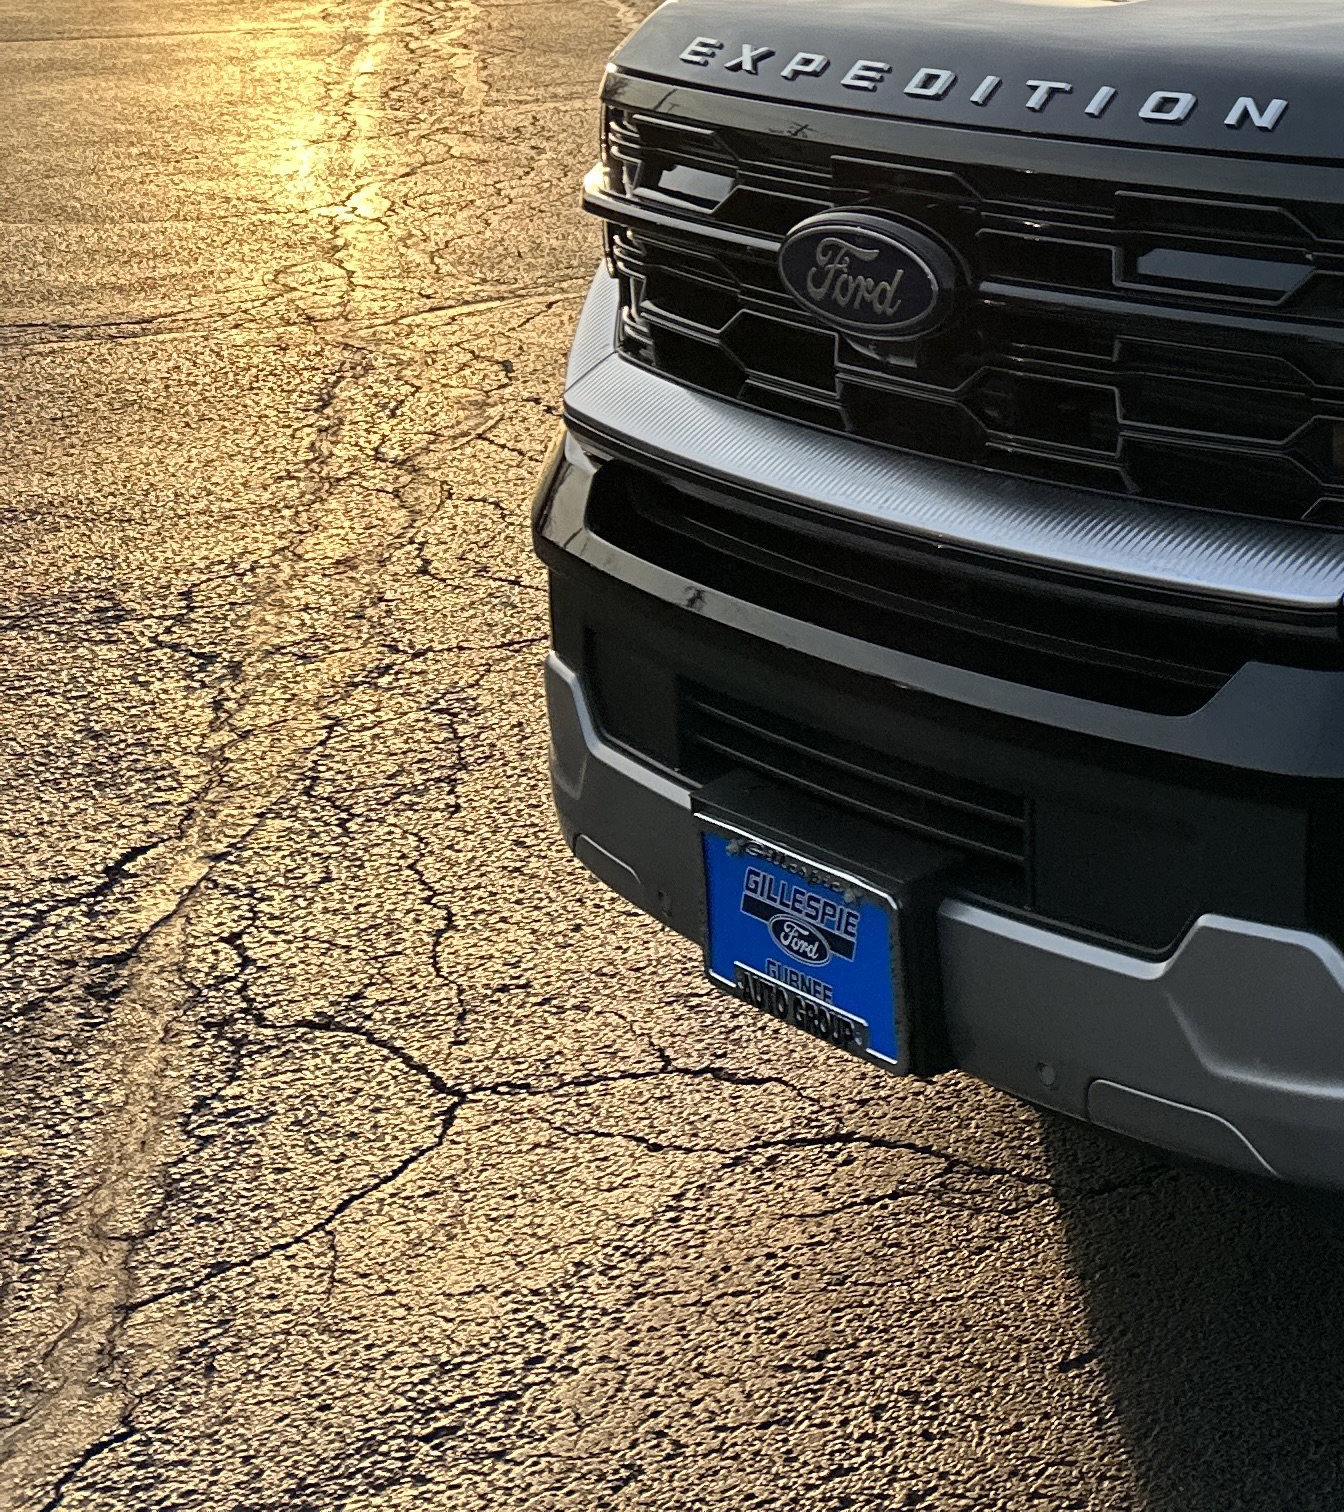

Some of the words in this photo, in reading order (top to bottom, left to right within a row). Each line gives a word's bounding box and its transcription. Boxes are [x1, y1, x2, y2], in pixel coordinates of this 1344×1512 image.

[680, 36, 1290, 131] EXPEDITION
[806, 237, 904, 317] Ford
[743, 867, 860, 939] GILLESPIE
[780, 921, 819, 960] Ford
[765, 958, 834, 1004] GURNEE
